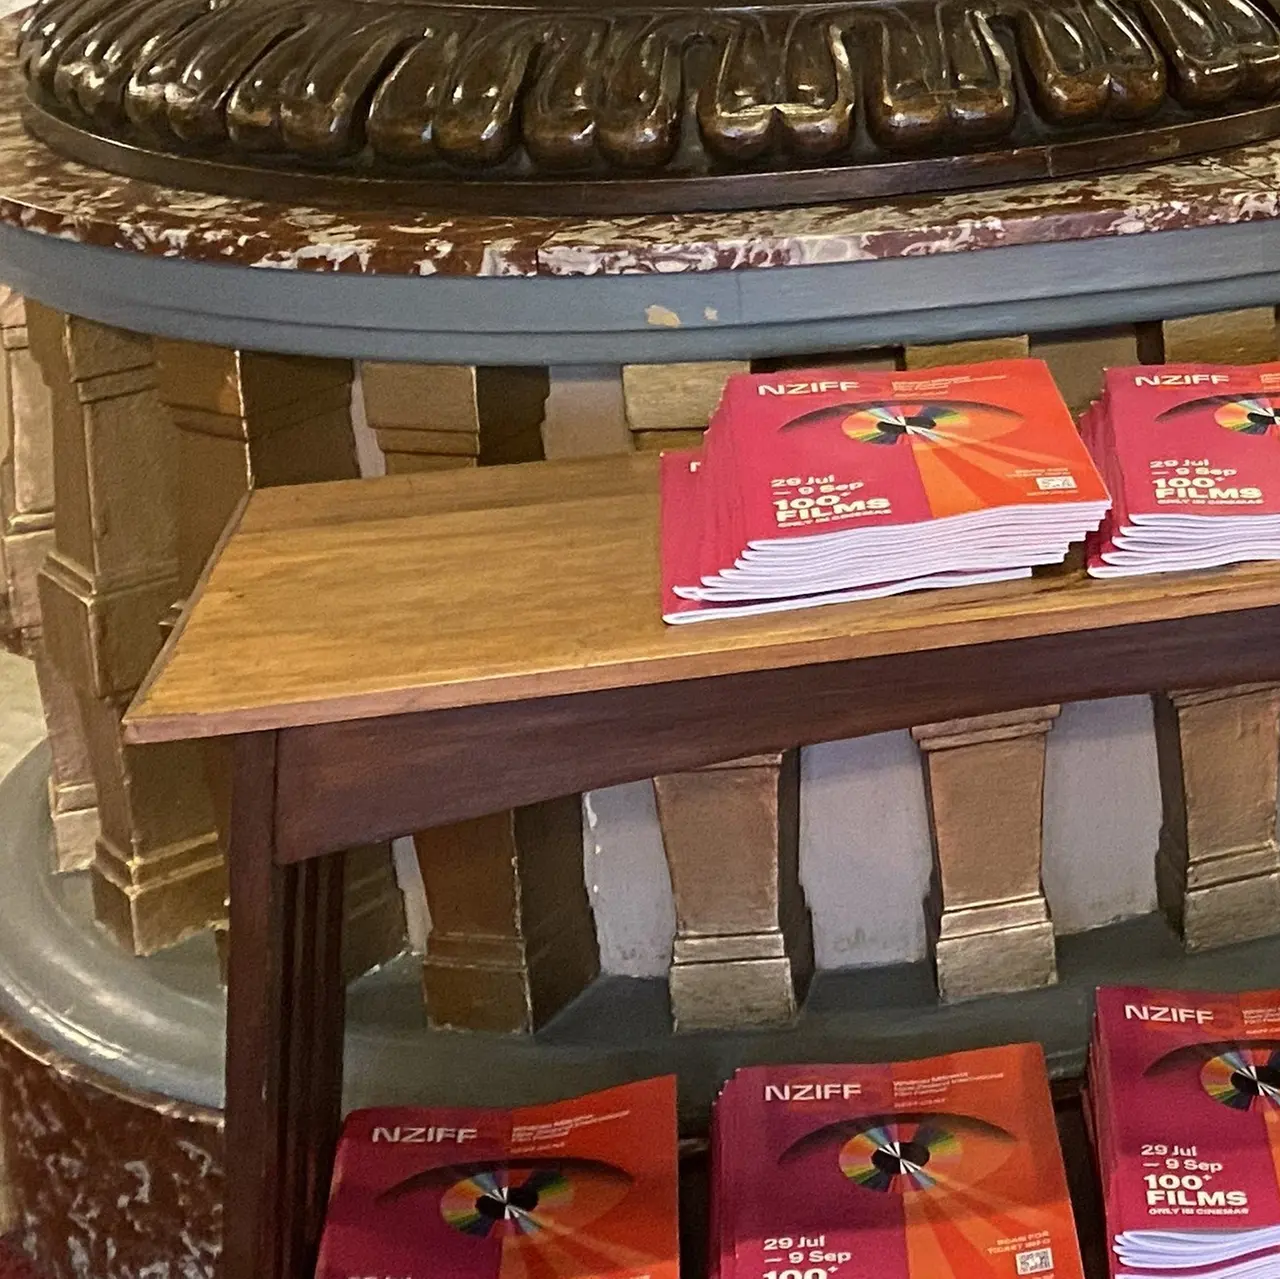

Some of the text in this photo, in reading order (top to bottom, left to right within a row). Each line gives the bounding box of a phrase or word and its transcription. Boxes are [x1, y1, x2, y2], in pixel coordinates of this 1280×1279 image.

[1134, 374, 1230, 387] NZIFF
[757, 381, 860, 396] NZIFF
[1155, 487, 1262, 500] FILMS
[776, 498, 890, 522] FILMS
[1124, 1004, 1214, 1024] NZIFF
[765, 1083, 862, 1101] NZIFF
[372, 1126, 478, 1143] NZIFF
[1141, 1144, 1198, 1157] 29 Jul
[1165, 1158, 1180, 1170] 9
[1183, 1158, 1224, 1173] Sep
[1146, 1190, 1248, 1206] FILMS
[763, 1235, 825, 1250] 29 Jul
[788, 1251, 804, 1264] 9
[808, 1250, 852, 1264] Sep
